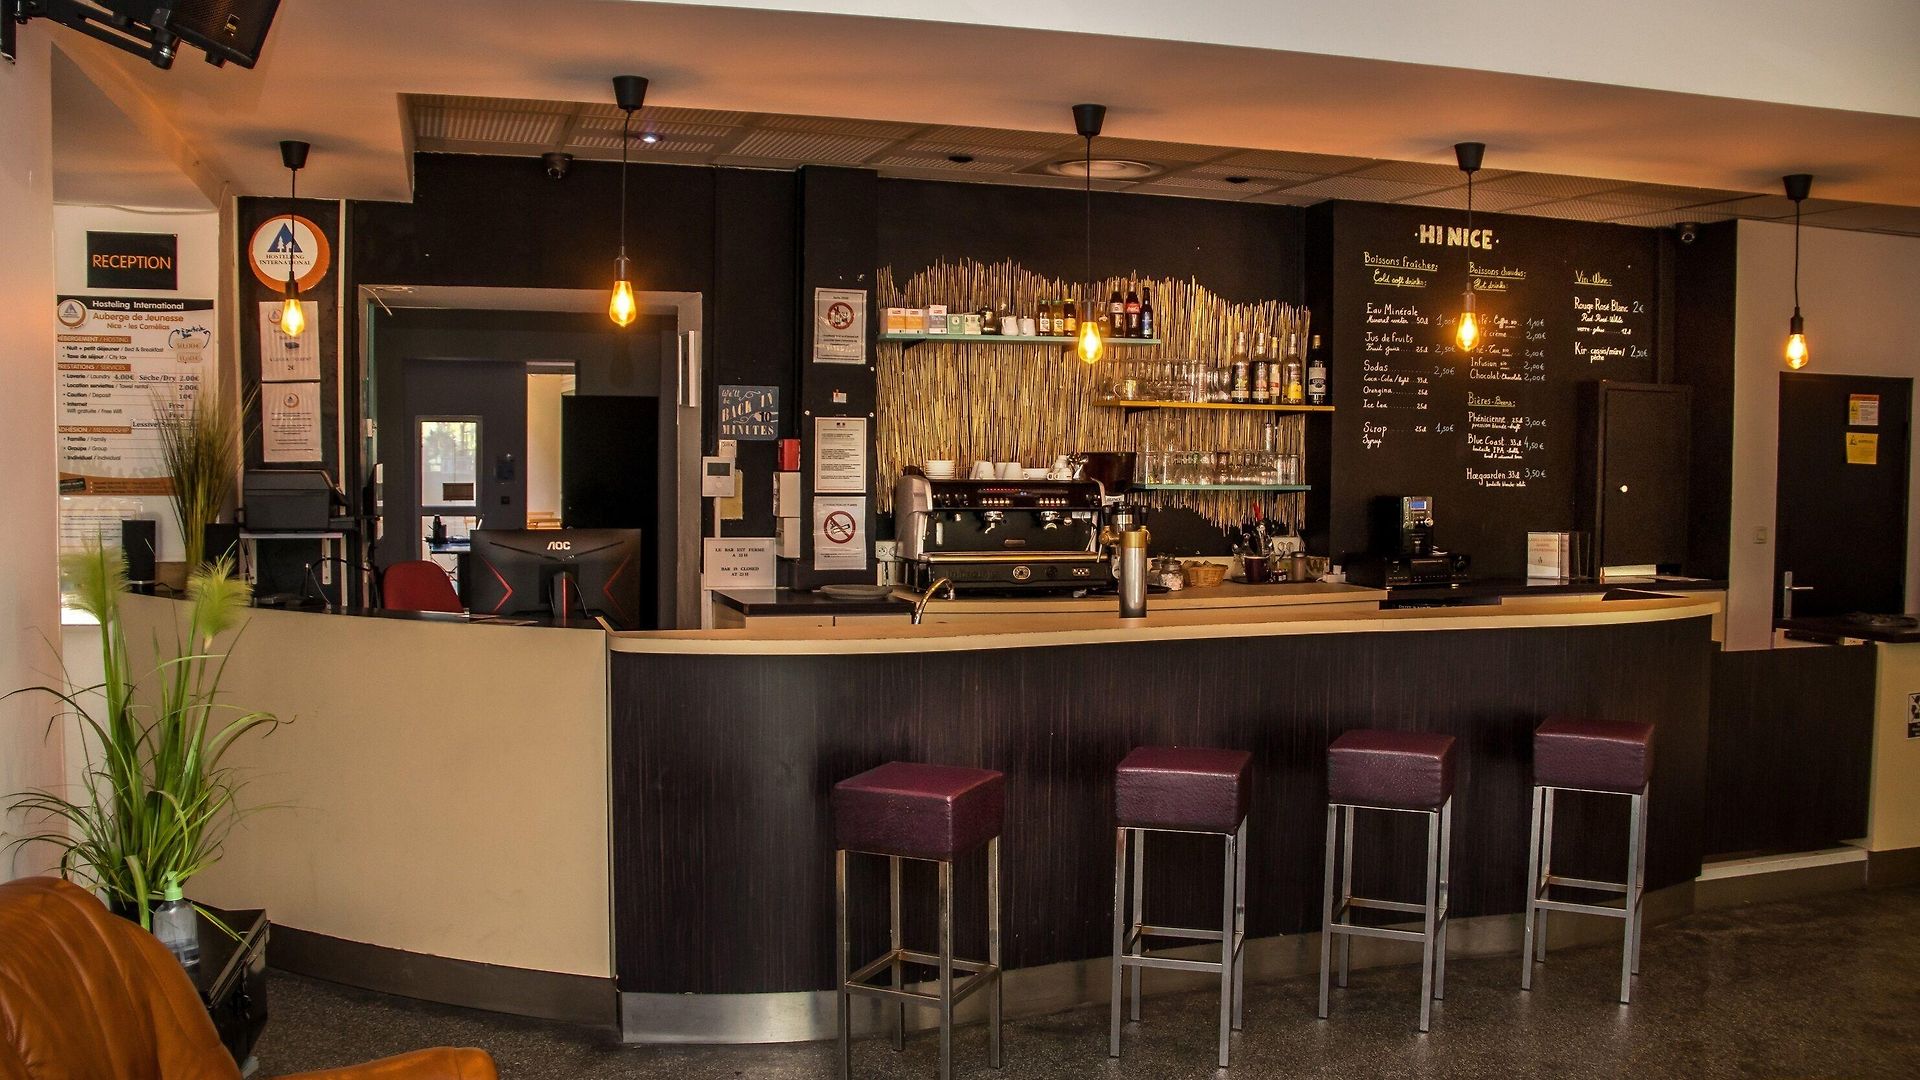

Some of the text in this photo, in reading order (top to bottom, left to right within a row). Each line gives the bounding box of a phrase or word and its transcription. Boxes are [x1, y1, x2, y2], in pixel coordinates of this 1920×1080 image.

[1420, 224, 1493, 250] HI NICE
[92, 254, 170, 269] RECEPTION
[1364, 251, 1400, 266] Boissons
[1469, 261, 1499, 276] Boissons
[1575, 270, 1589, 283] Vin
[92, 301, 130, 309] Hosteling
[1366, 302, 1418, 316] Eau Minérale
[1574, 296, 1594, 313] Rouge
[1611, 300, 1628, 312] Blanc
[92, 312, 130, 322] Auberge
[1365, 331, 1413, 343] Jus de fruits
[1574, 341, 1587, 354] Kir
[1363, 359, 1388, 372] Sodas
[1471, 357, 1497, 367] Infusion
[1470, 368, 1500, 379] Chocolat
[1524, 373, 1546, 382] 2,00€
[761, 390, 774, 408] IN
[1363, 399, 1374, 408] Ice
[1468, 392, 1491, 405] Bières
[722, 400, 751, 422] BACK
[760, 412, 771, 421] 10
[722, 424, 774, 435] MINUTES
[1363, 422, 1388, 437] Sirop
[1468, 433, 1483, 444] Blue
[1484, 436, 1504, 446] Coast
[546, 541, 571, 550] AOC
